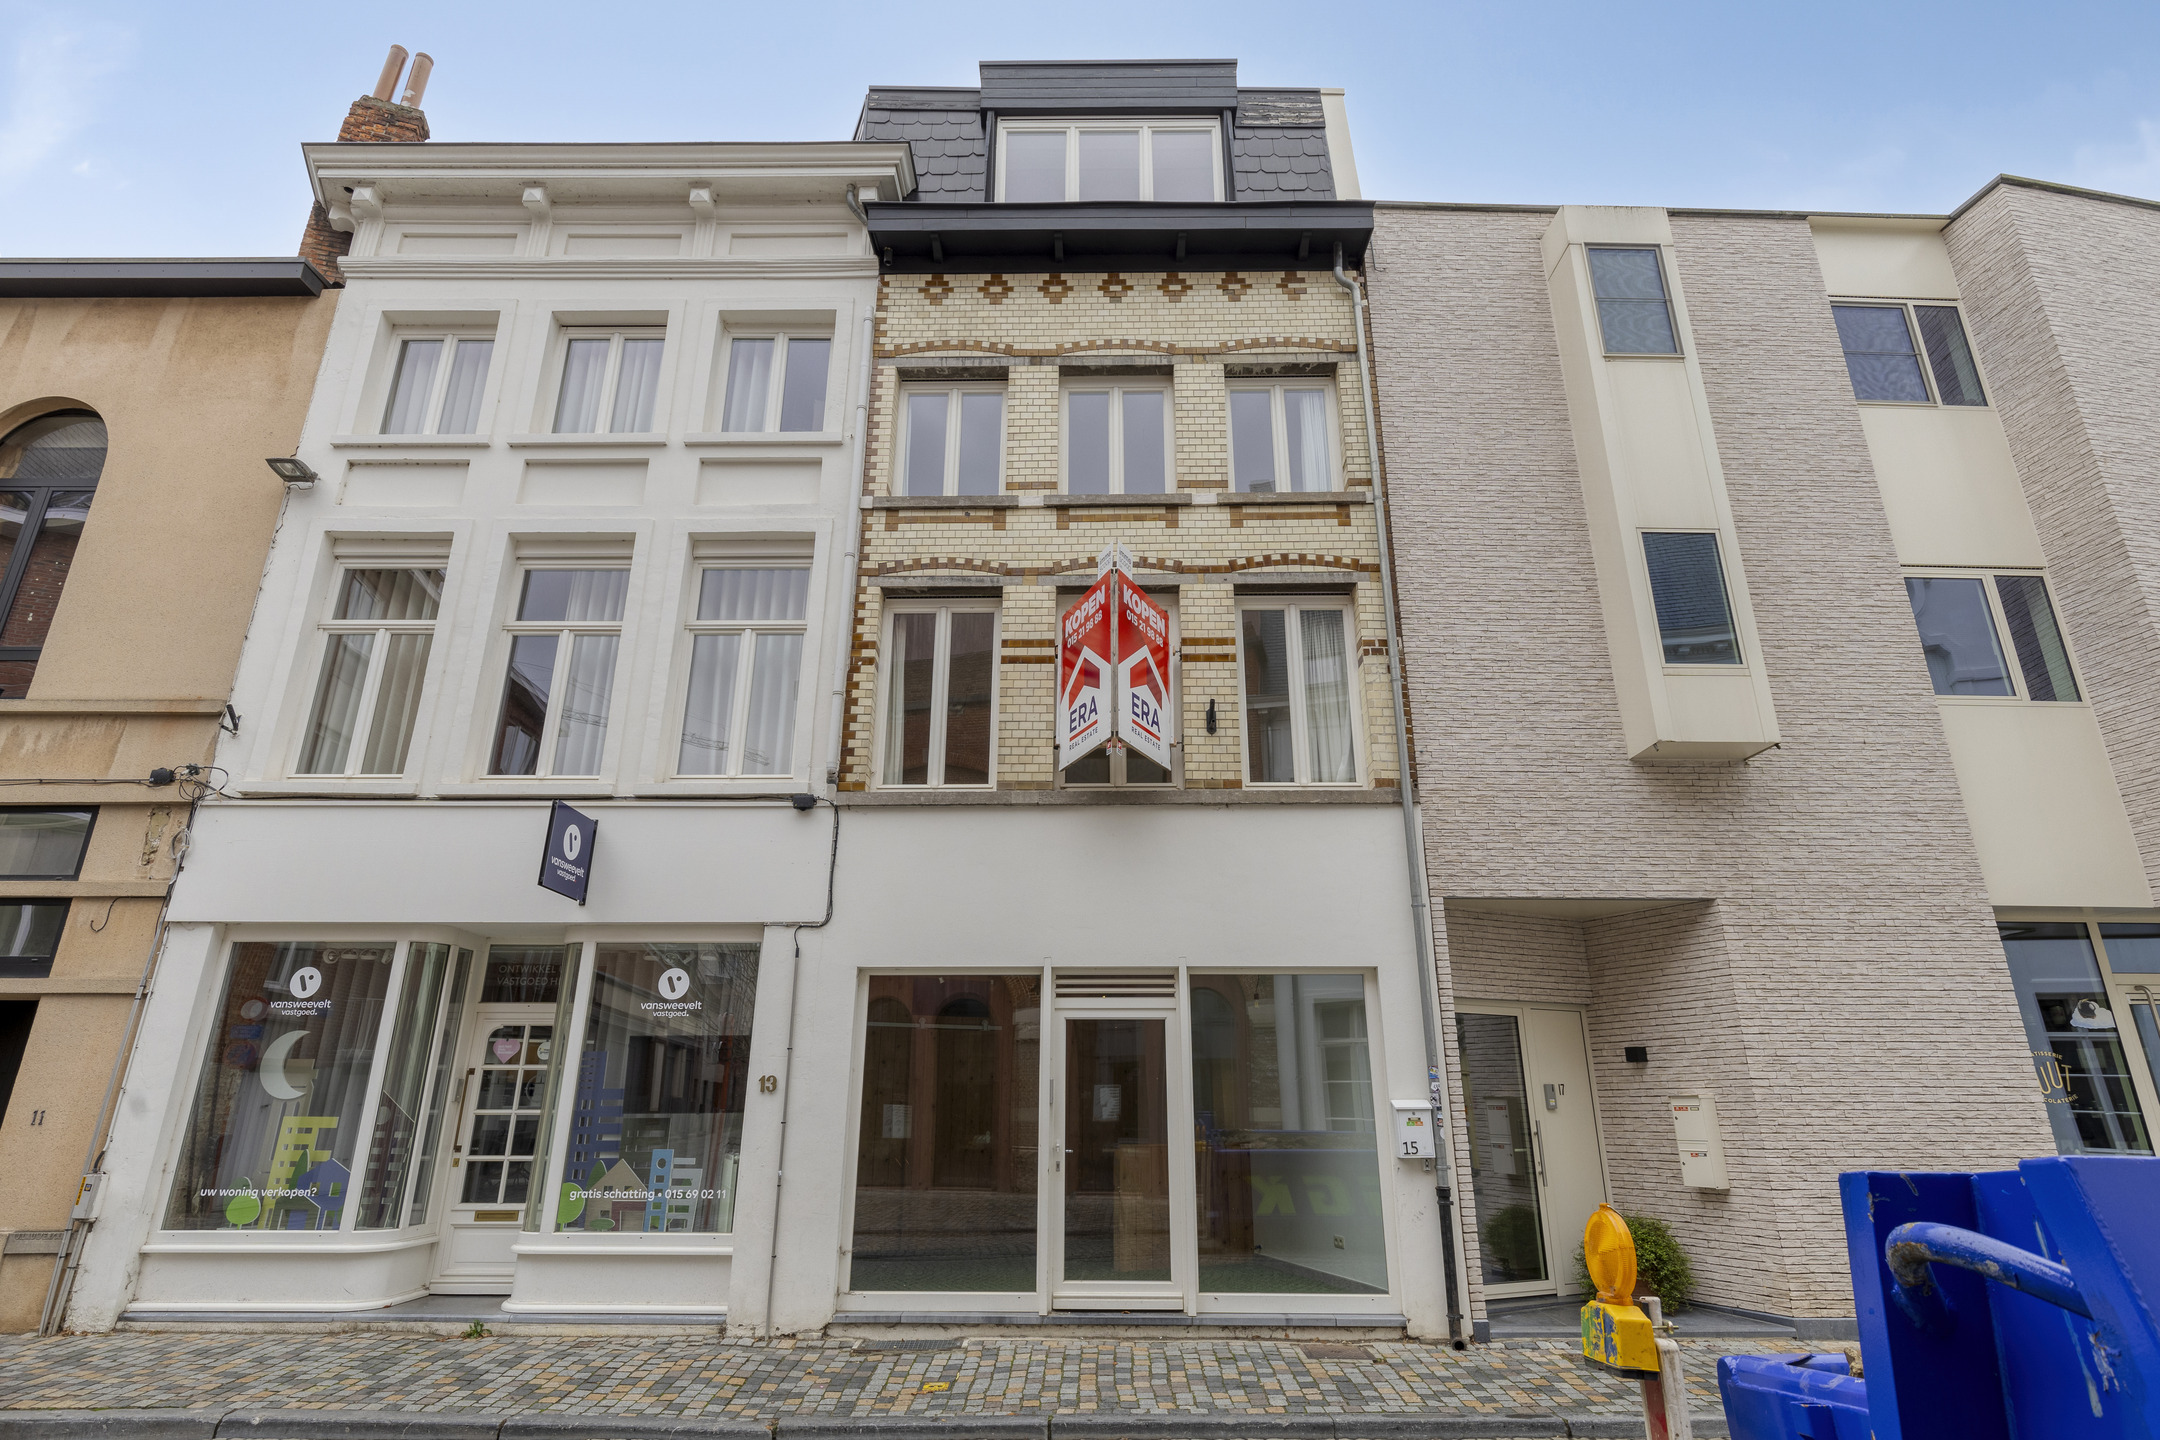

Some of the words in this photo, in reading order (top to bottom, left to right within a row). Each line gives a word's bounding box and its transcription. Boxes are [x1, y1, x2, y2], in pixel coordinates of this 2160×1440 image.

[1065, 584, 1105, 638] KOPEN
[1123, 583, 1166, 637] KOPEN
[1067, 632, 1078, 649] 015
[1078, 625, 1085, 639] 21
[1085, 617, 1094, 633] 98
[1094, 609, 1103, 625] 88
[1126, 609, 1138, 626] 015
[1139, 620, 1146, 633] 21
[1146, 626, 1155, 641] 98
[1155, 633, 1164, 648] 88
[1069, 695, 1098, 734] ERA
[1131, 691, 1161, 733] ERA
[1069, 739, 1080, 751] REAL
[1081, 726, 1098, 743] ESTATE
[1131, 725, 1143, 739] REAL
[1144, 734, 1161, 751] ESTATE
[551, 855, 585, 878] vansweevelt
[498, 964, 557, 974] ONTWIKKEL
[496, 976, 548, 986] VASTGOED
[270, 999, 332, 1009] vansweevelt
[640, 1000, 703, 1010] vansweevelt
[281, 1008, 318, 1017] vastgoed.
[652, 1010, 690, 1019] vastgoed.
[2031, 1051, 2063, 1060] ATISSERIE
[758, 1074, 778, 1093] 13
[2039, 1061, 2072, 1095] UUT
[1557, 1083, 1565, 1096] 17
[2043, 1094, 2079, 1104] COLATERIE
[30, 1109, 46, 1126] 11
[1402, 1141, 1419, 1156] 15
[200, 1188, 217, 1197] uw
[219, 1187, 259, 1199] woning
[261, 1187, 318, 1199] verkopen?
[569, 1189, 602, 1201] gratis
[603, 1189, 655, 1201] schatting
[664, 1189, 683, 1199] 015
[685, 1189, 698, 1199] 69
[700, 1189, 714, 1199] 02
[716, 1189, 727, 1199] 11
